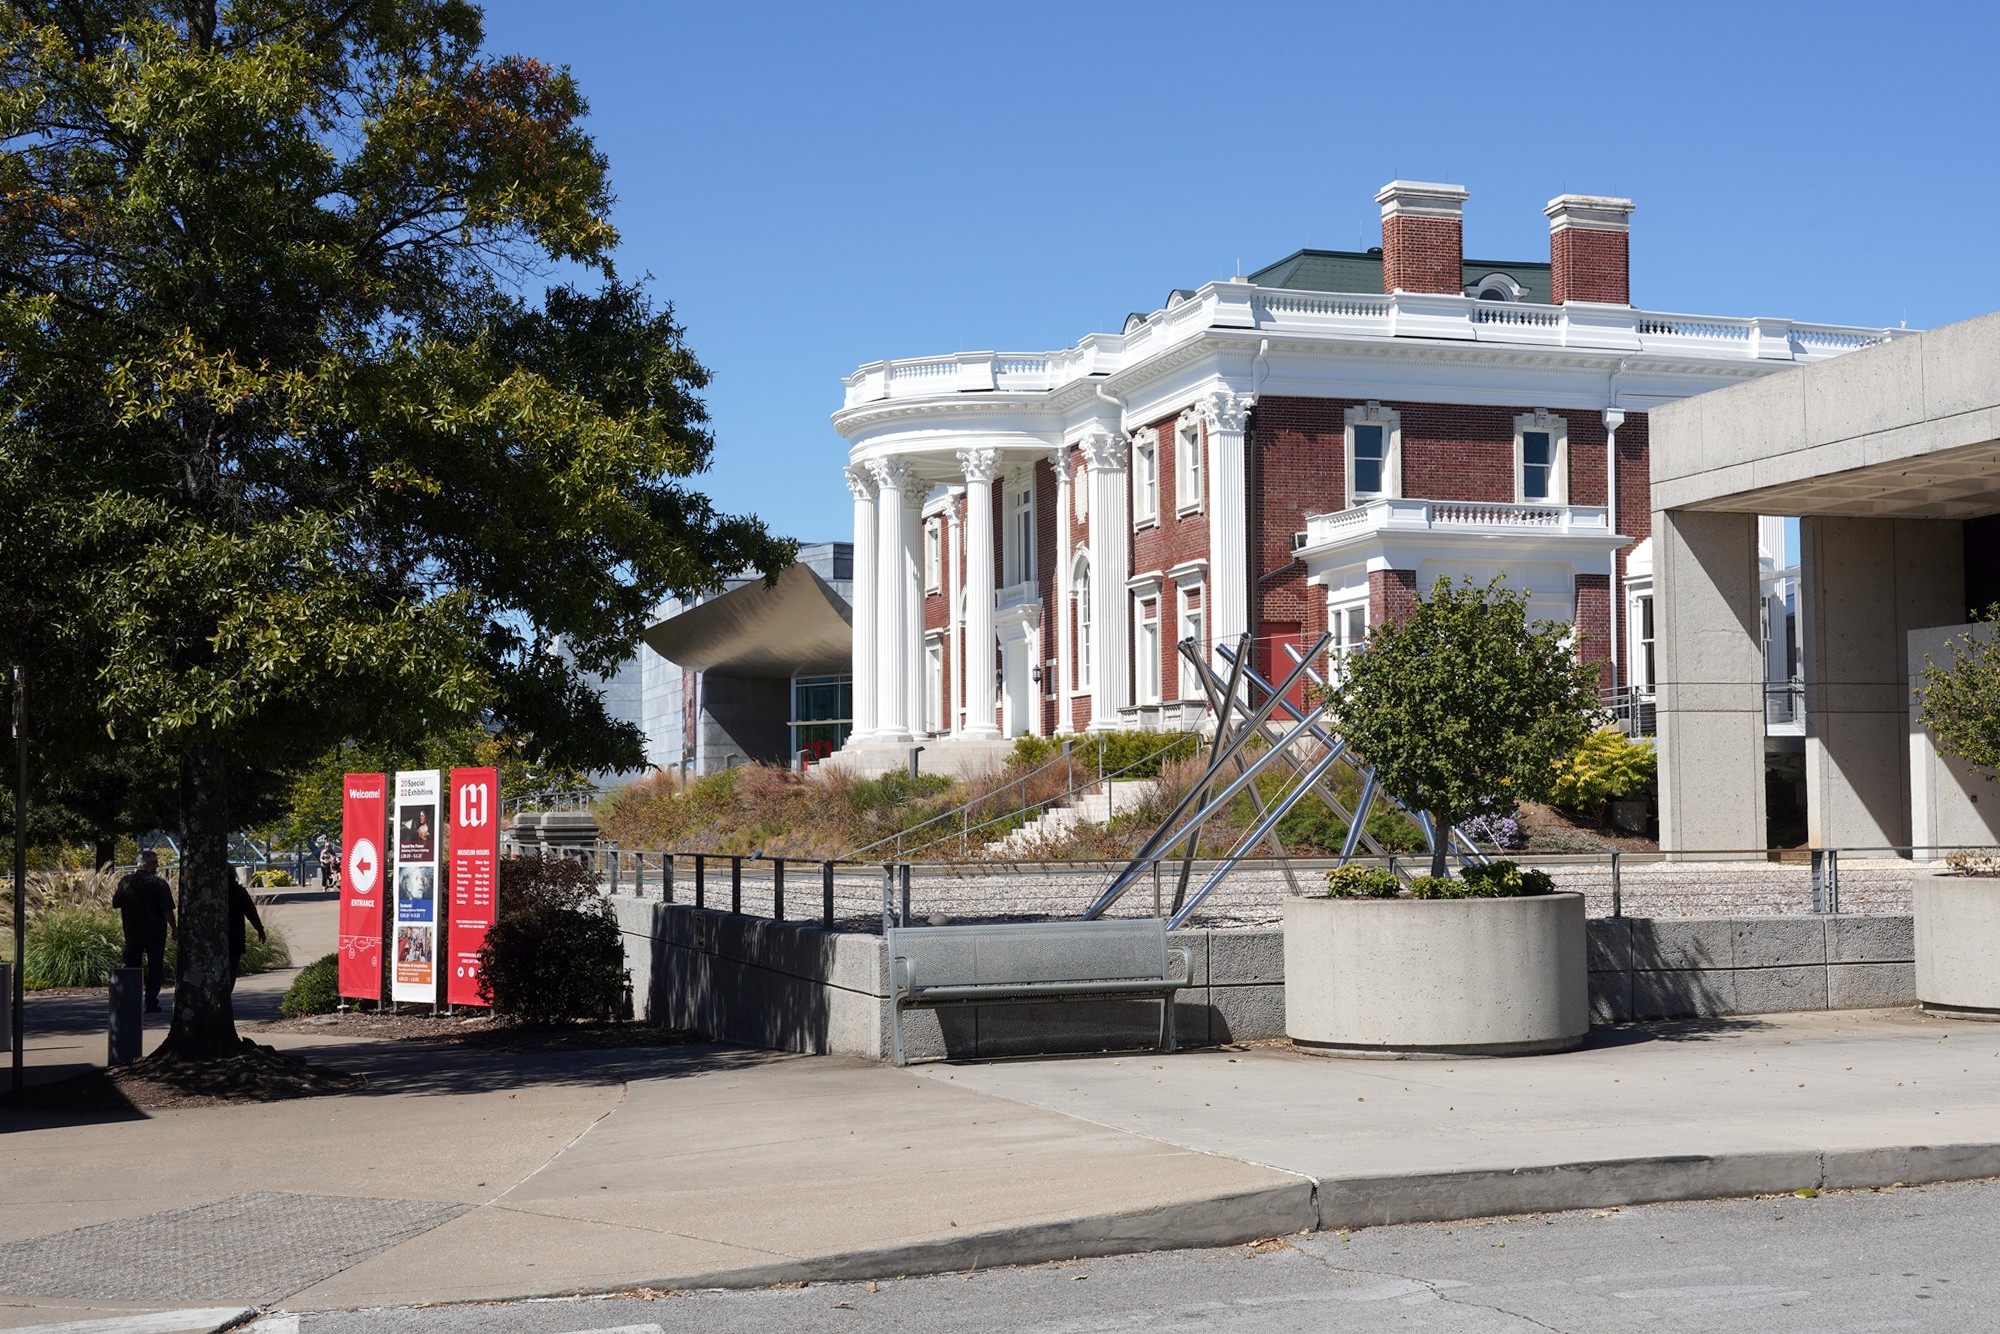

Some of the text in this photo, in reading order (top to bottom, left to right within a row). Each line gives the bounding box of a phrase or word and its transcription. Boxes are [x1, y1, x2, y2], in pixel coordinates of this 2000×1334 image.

[408, 779, 425, 788] Special
[350, 788, 380, 800] Welcome!
[408, 789, 434, 797] Exhibitions
[351, 899, 375, 908] ENTRANCE
